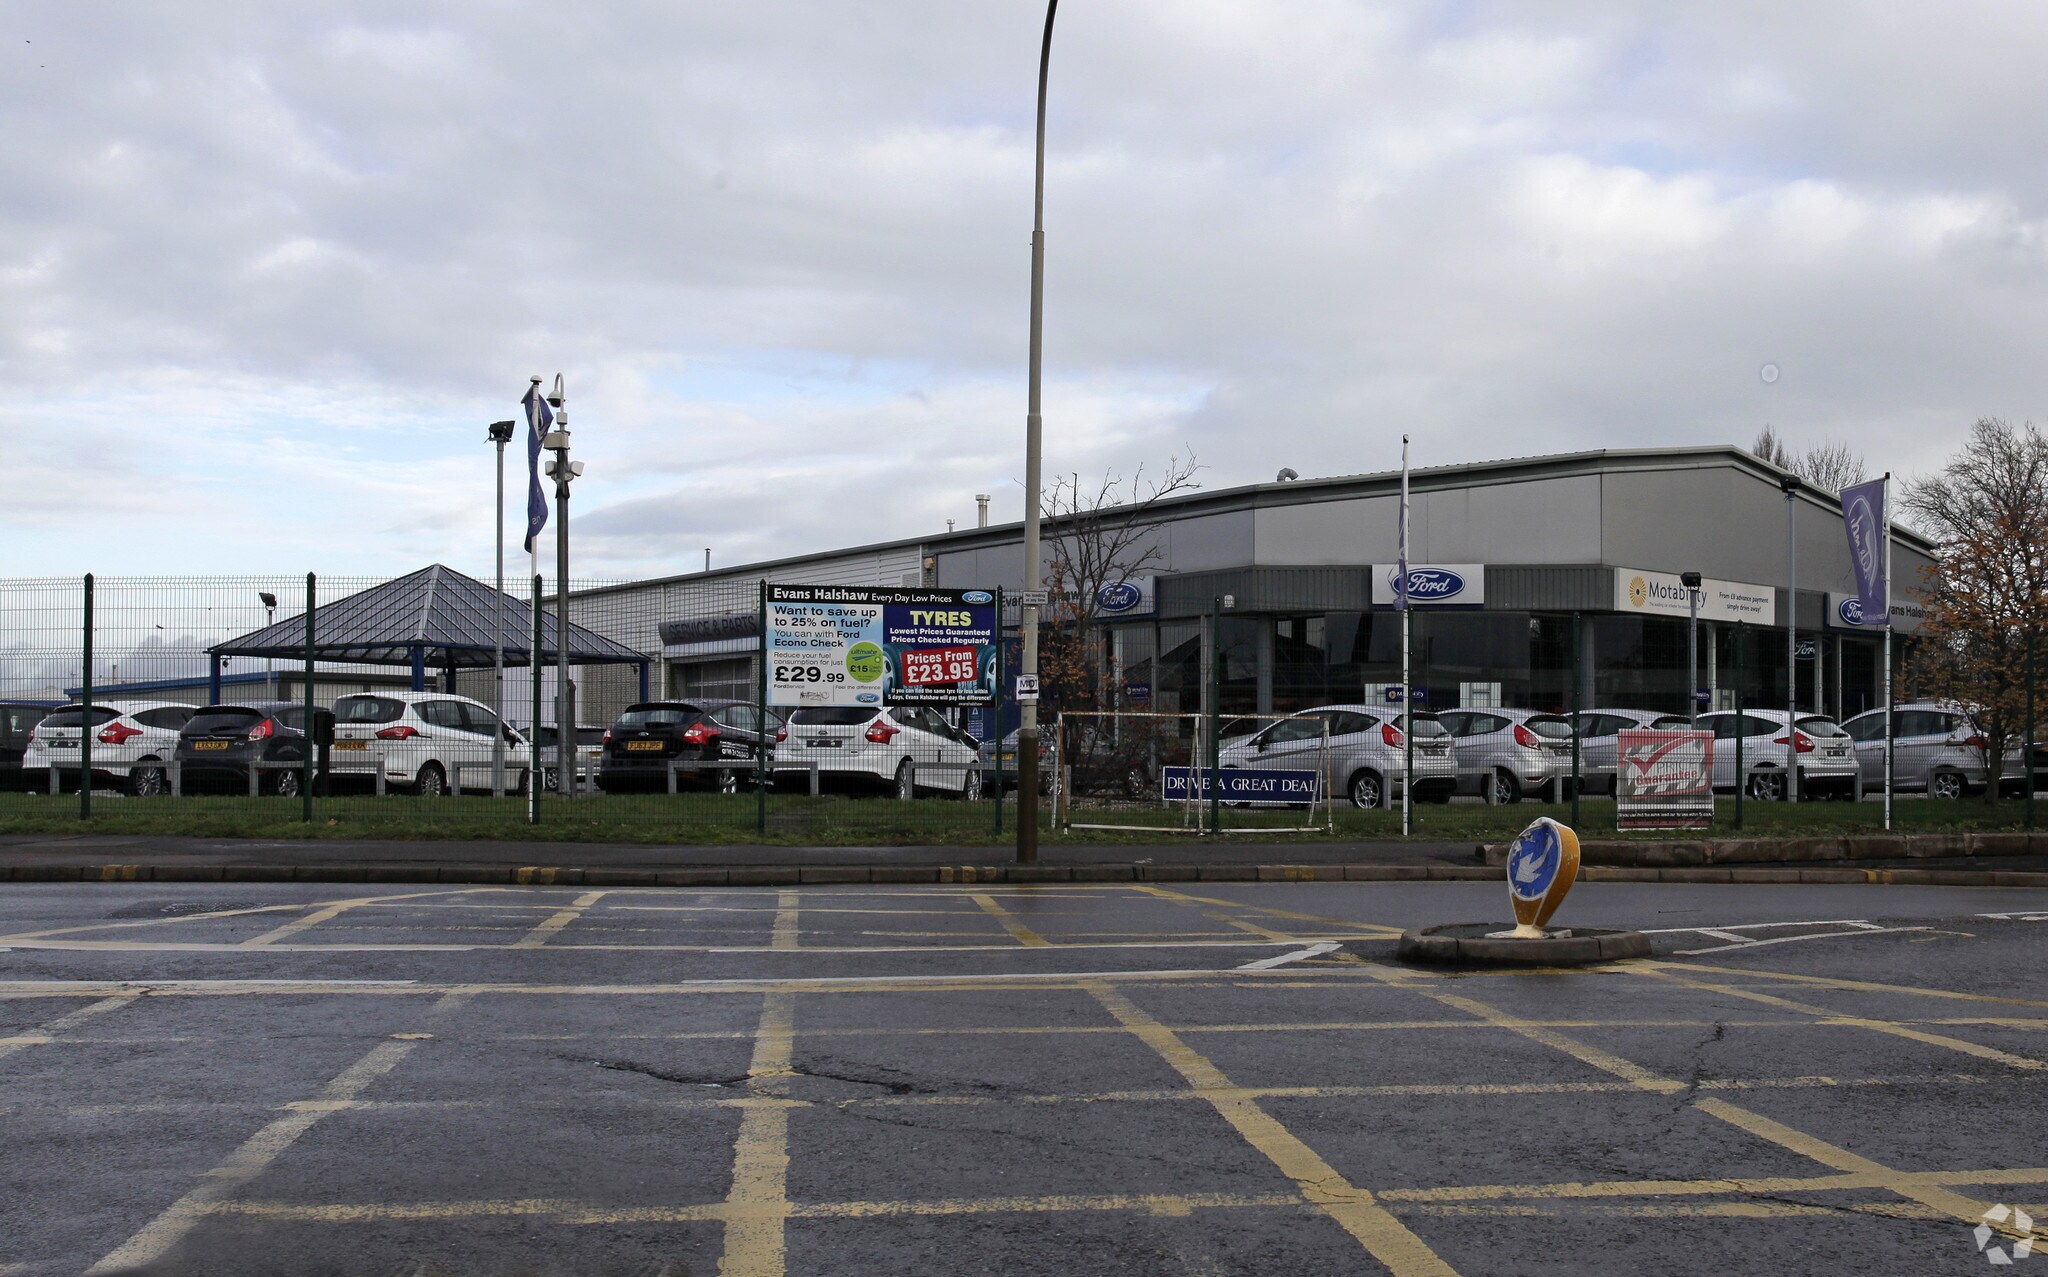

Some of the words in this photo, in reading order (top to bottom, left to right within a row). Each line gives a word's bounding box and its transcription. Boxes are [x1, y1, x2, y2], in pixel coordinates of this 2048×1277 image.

[1408, 573, 1450, 592] Ford
[774, 588, 811, 599] Evans
[815, 589, 868, 600] Halshaw
[872, 593, 892, 603] Every
[895, 594, 910, 603] Day
[912, 594, 928, 602] Low
[930, 595, 952, 603] Prices
[1002, 596, 1023, 607] Evan
[1104, 587, 1129, 605] Ford
[1649, 581, 1707, 608] Motabity
[774, 606, 807, 615] Want
[812, 607, 823, 616] to
[861, 609, 877, 618] up
[1727, 603, 1739, 611] simply
[1847, 602, 1863, 618] For
[775, 617, 787, 626] to
[791, 618, 817, 627] 25%
[821, 619, 836, 627] on
[841, 619, 870, 628] fuel?
[910, 611, 971, 626] TYRES
[669, 621, 712, 639] SERVICE
[713, 620, 720, 633] &
[722, 616, 757, 633] PARTS
[815, 630, 834, 638] with
[775, 639, 807, 647] Econo
[1795, 641, 1815, 655] For
[907, 653, 942, 664] Prices
[945, 651, 972, 662] From
[775, 666, 845, 682] £29.99
[907, 662, 974, 683] £23.95
[1218, 778, 1226, 790] A
[1231, 778, 1276, 791] GREAT
[1282, 779, 1315, 792] DEAL
[1636, 771, 1697, 785] Guarantee
